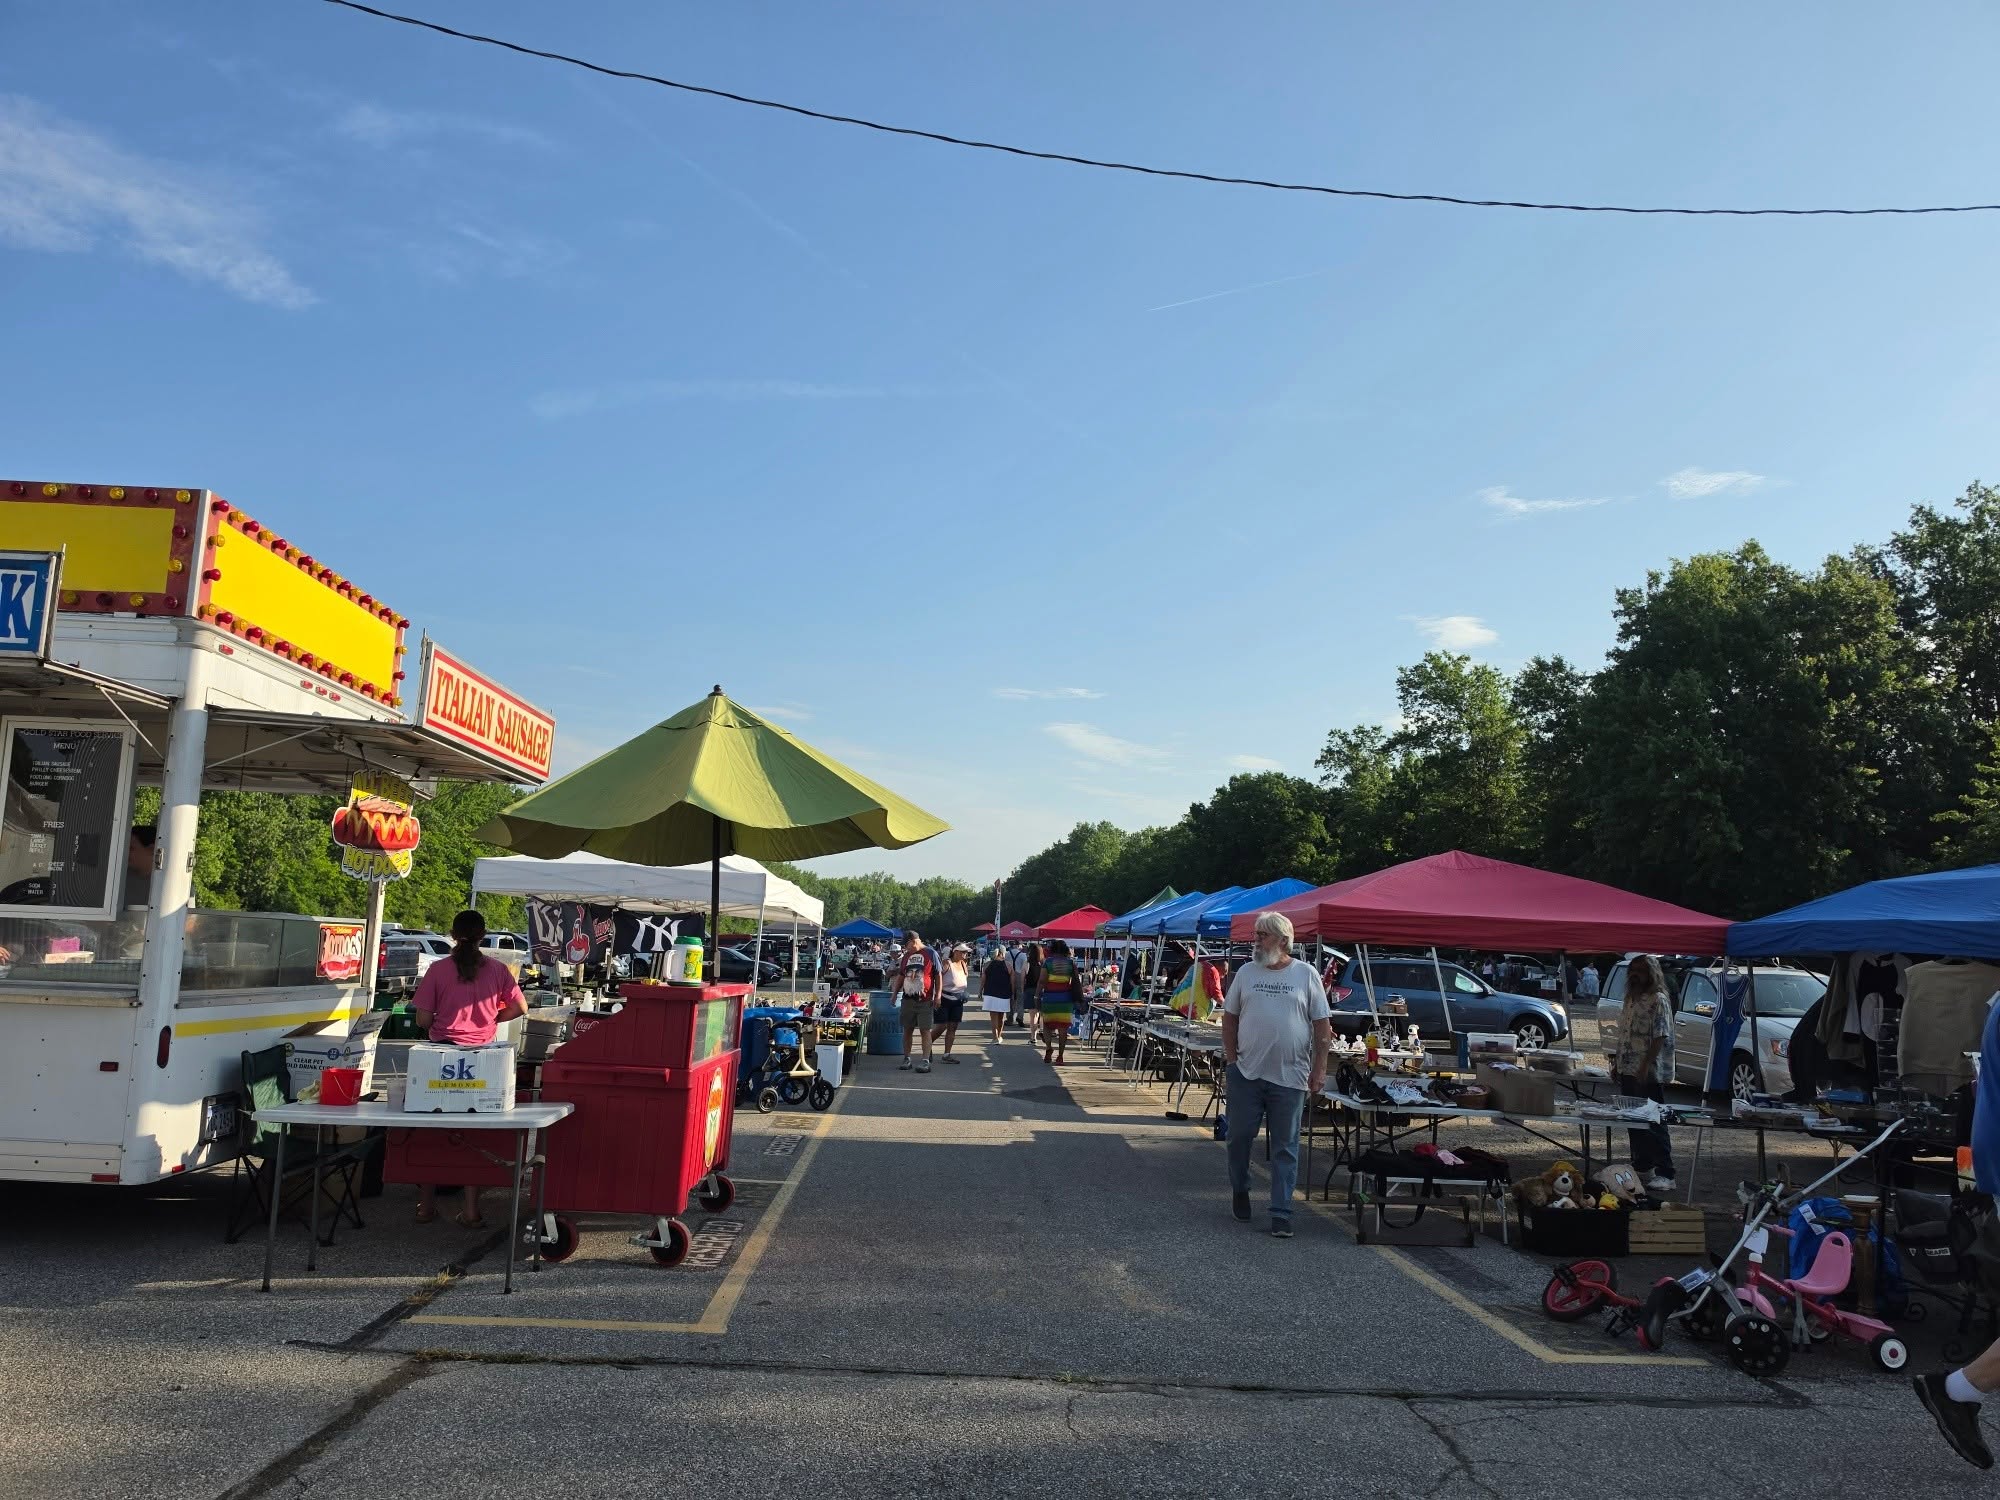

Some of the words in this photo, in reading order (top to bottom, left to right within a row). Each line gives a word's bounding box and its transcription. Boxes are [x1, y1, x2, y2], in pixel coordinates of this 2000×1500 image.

[432, 666, 495, 739] ITALIAN
[494, 702, 549, 766] SAUSAGE
[70, 730, 92, 738] FOOD
[43, 821, 65, 829] FRIES
[343, 844, 374, 875] HOT
[373, 849, 411, 877] DOGS
[320, 929, 362, 960] HOTDOGS
[441, 1058, 476, 1080] sk
